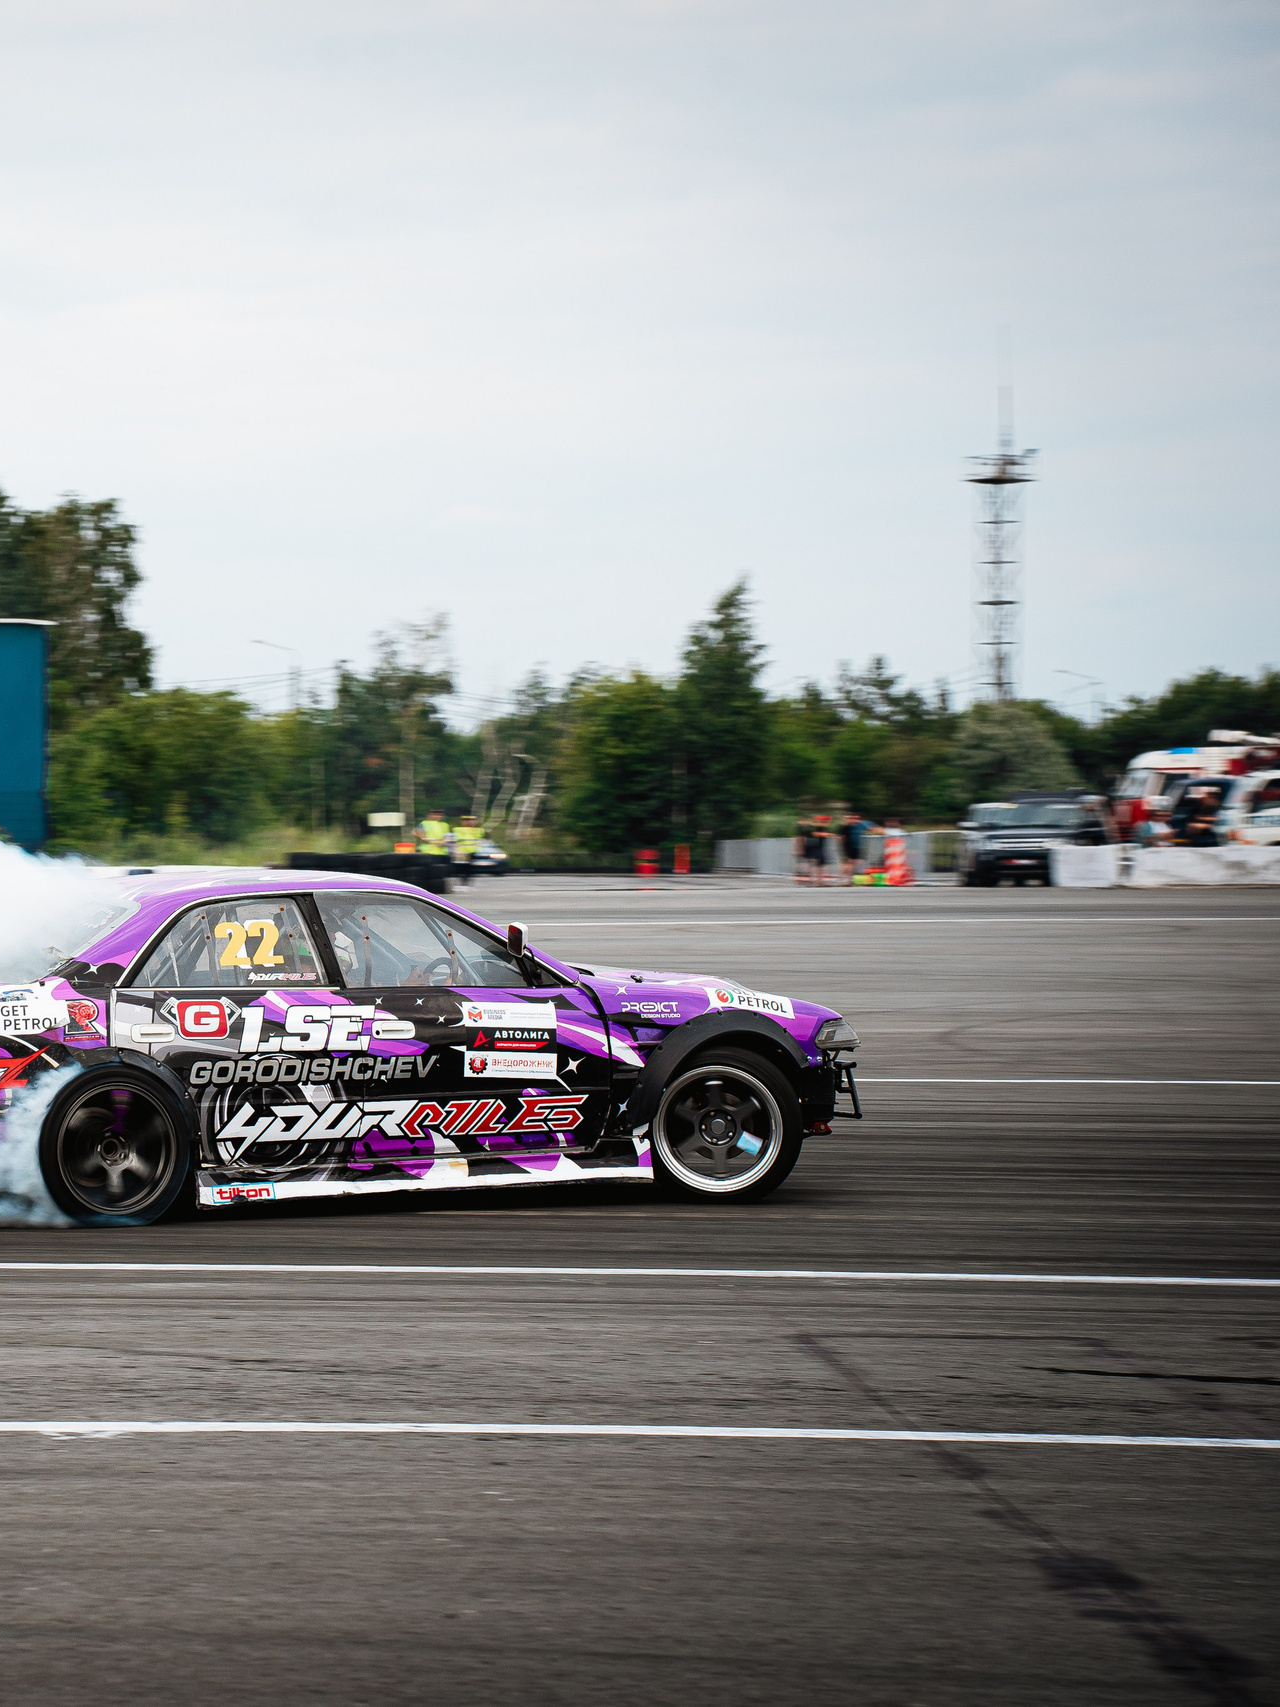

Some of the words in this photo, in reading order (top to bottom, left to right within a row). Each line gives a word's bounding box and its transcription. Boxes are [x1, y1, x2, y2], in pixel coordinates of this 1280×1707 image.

[214, 921, 284, 966] 22
[0, 1005, 28, 1017] GET
[737, 995, 787, 1014] PETROL
[184, 1005, 221, 1033] G
[494, 1030, 550, 1039] АВТОЛИГА
[189, 1054, 437, 1085] GORODISHCHEV
[491, 1058, 553, 1068] ВНЕДОРОЖНИК
[216, 1187, 271, 1200] tilton
